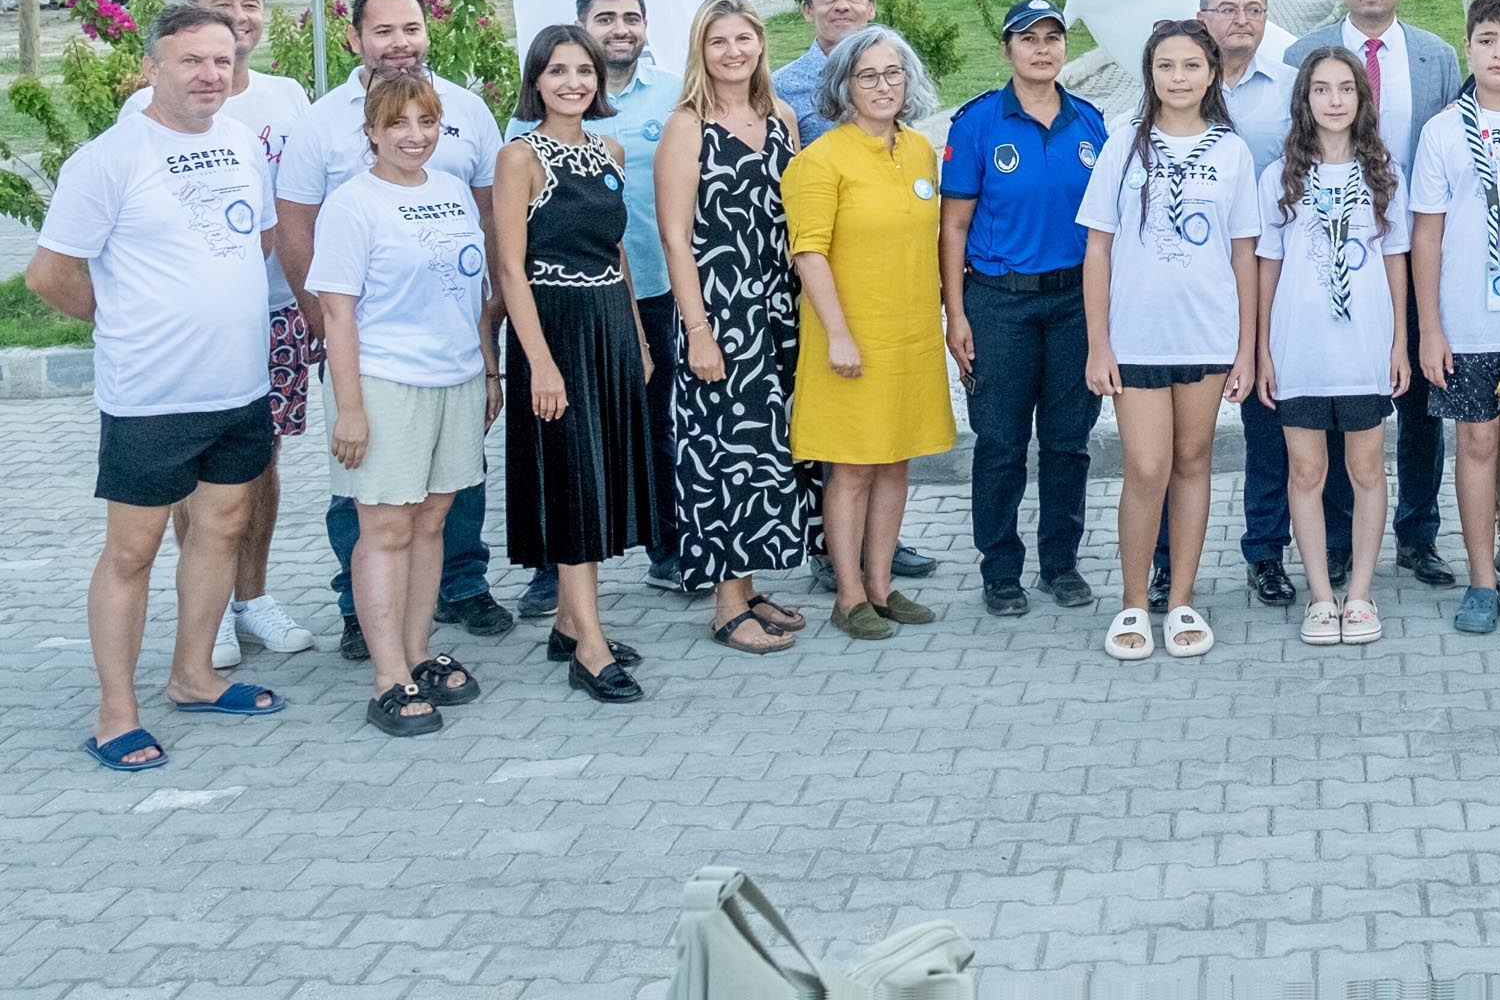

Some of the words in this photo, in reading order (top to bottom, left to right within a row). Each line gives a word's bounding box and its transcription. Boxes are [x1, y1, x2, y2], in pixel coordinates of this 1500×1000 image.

[166, 148, 236, 165] CARETTA
[169, 157, 240, 174] CARETTA
[398, 202, 462, 213] CARETTA
[403, 209, 466, 221] CARETTA
